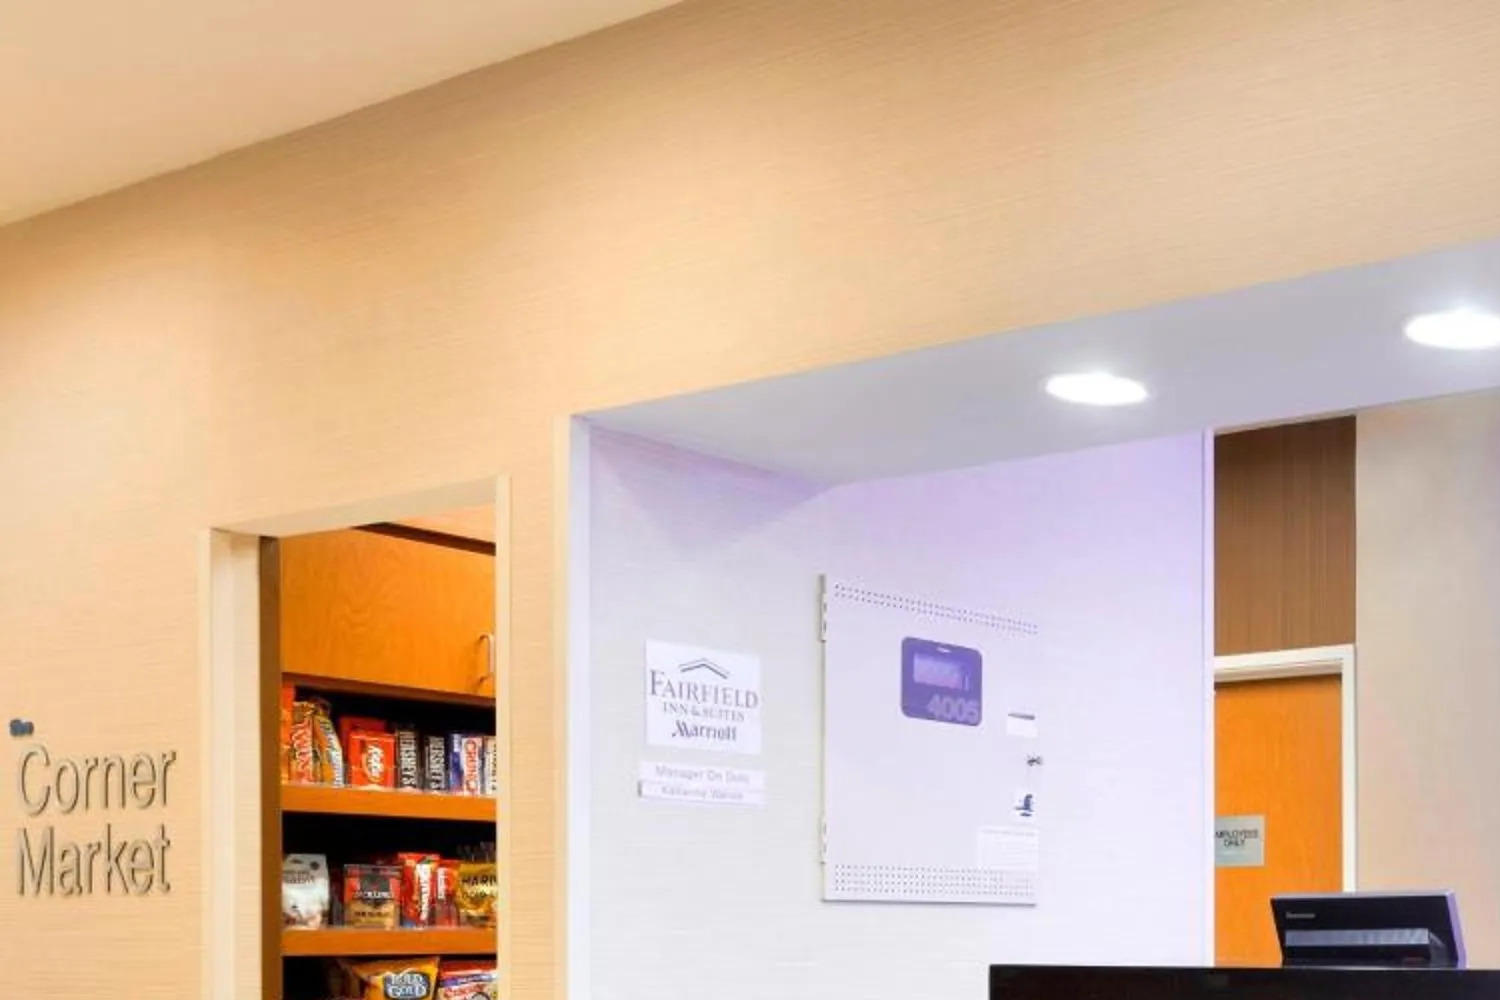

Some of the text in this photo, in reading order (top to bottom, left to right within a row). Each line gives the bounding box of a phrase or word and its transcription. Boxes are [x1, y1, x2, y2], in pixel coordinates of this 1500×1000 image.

[650, 669, 759, 709] FAIRFIELD
[663, 701, 745, 722] INN & SUITES
[672, 720, 737, 741] Marriott
[19, 744, 178, 816] Corner
[17, 822, 172, 896] Market
